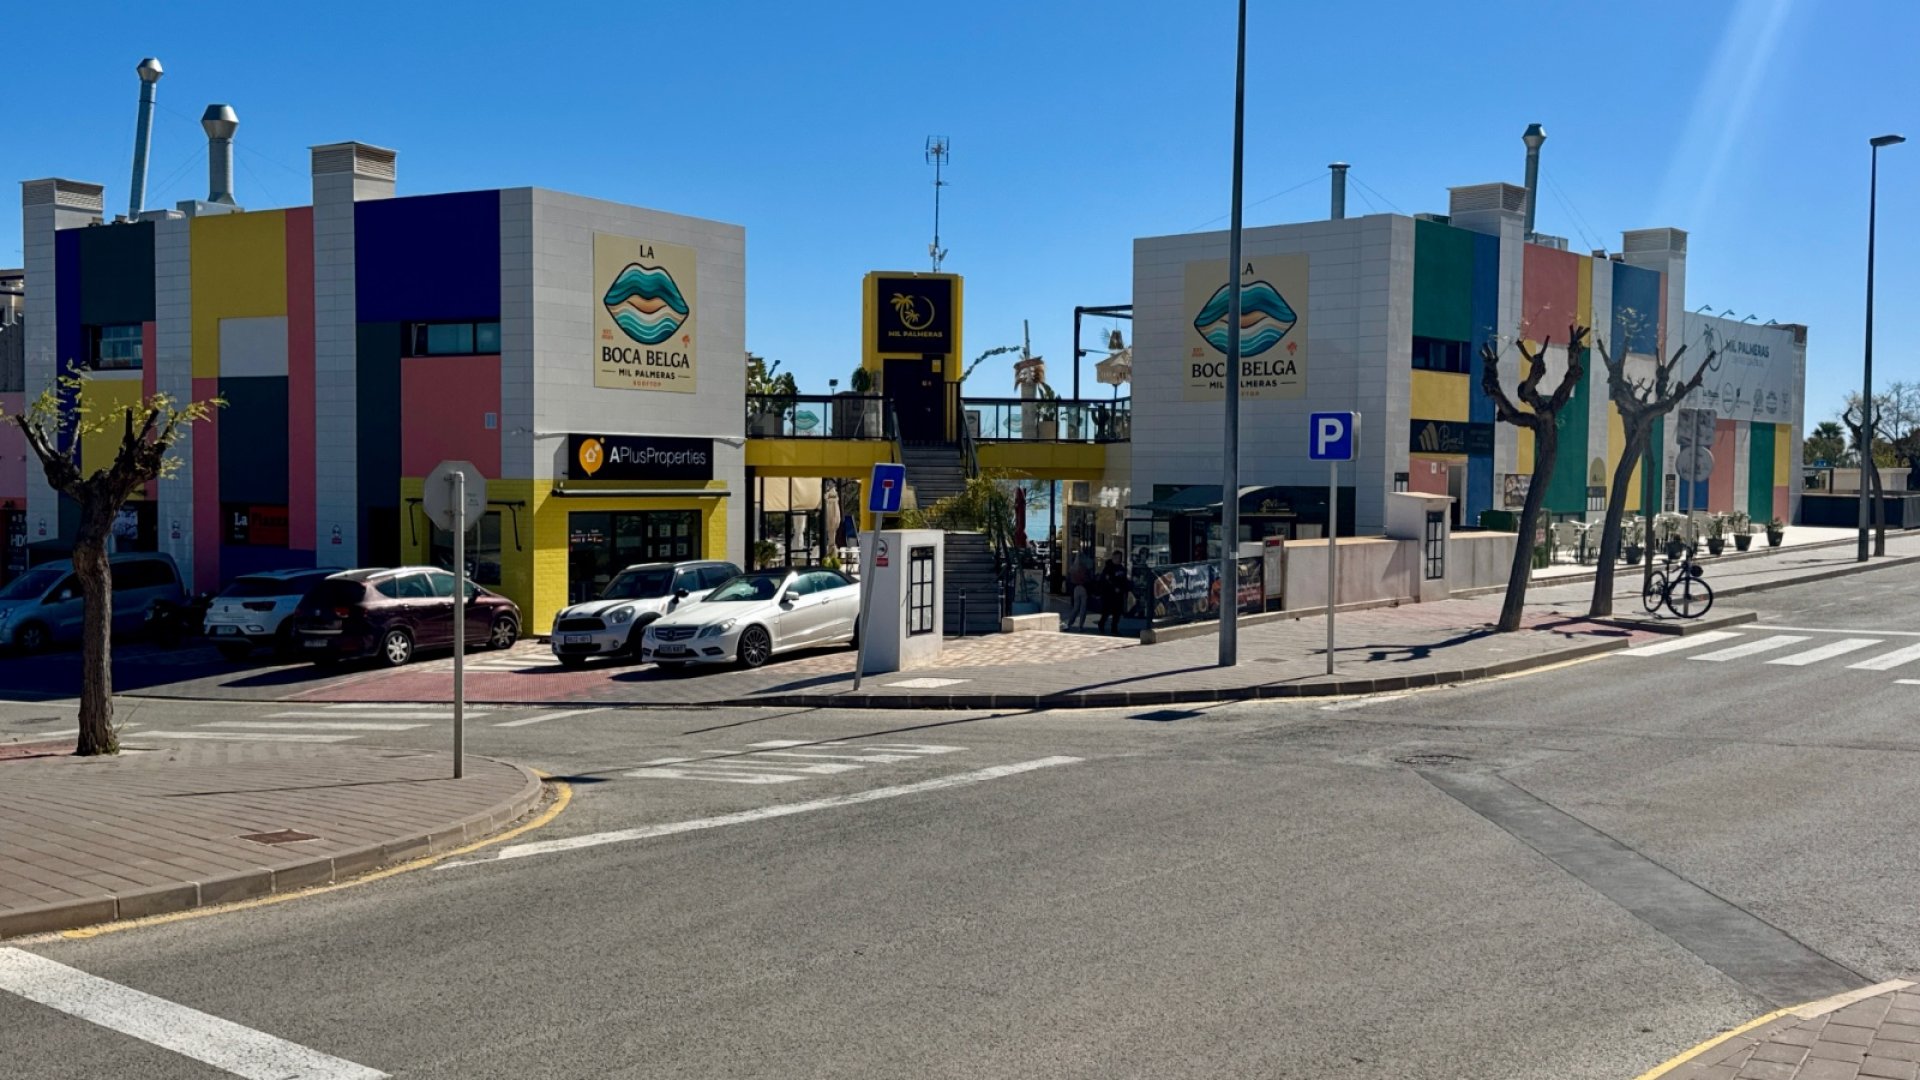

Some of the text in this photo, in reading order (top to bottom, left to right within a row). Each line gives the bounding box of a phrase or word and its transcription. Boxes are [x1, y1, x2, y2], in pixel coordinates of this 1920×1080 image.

[639, 244, 654, 259] LA
[602, 346, 690, 369] BOCA BELGA
[618, 368, 676, 380] MIL PALMERAS
[1242, 360, 1297, 376] BELGA
[1209, 379, 1278, 389] MIL LMERAS
[1318, 418, 1344, 455] P
[609, 445, 706, 467] APlusProperties
[234, 511, 248, 526] La
